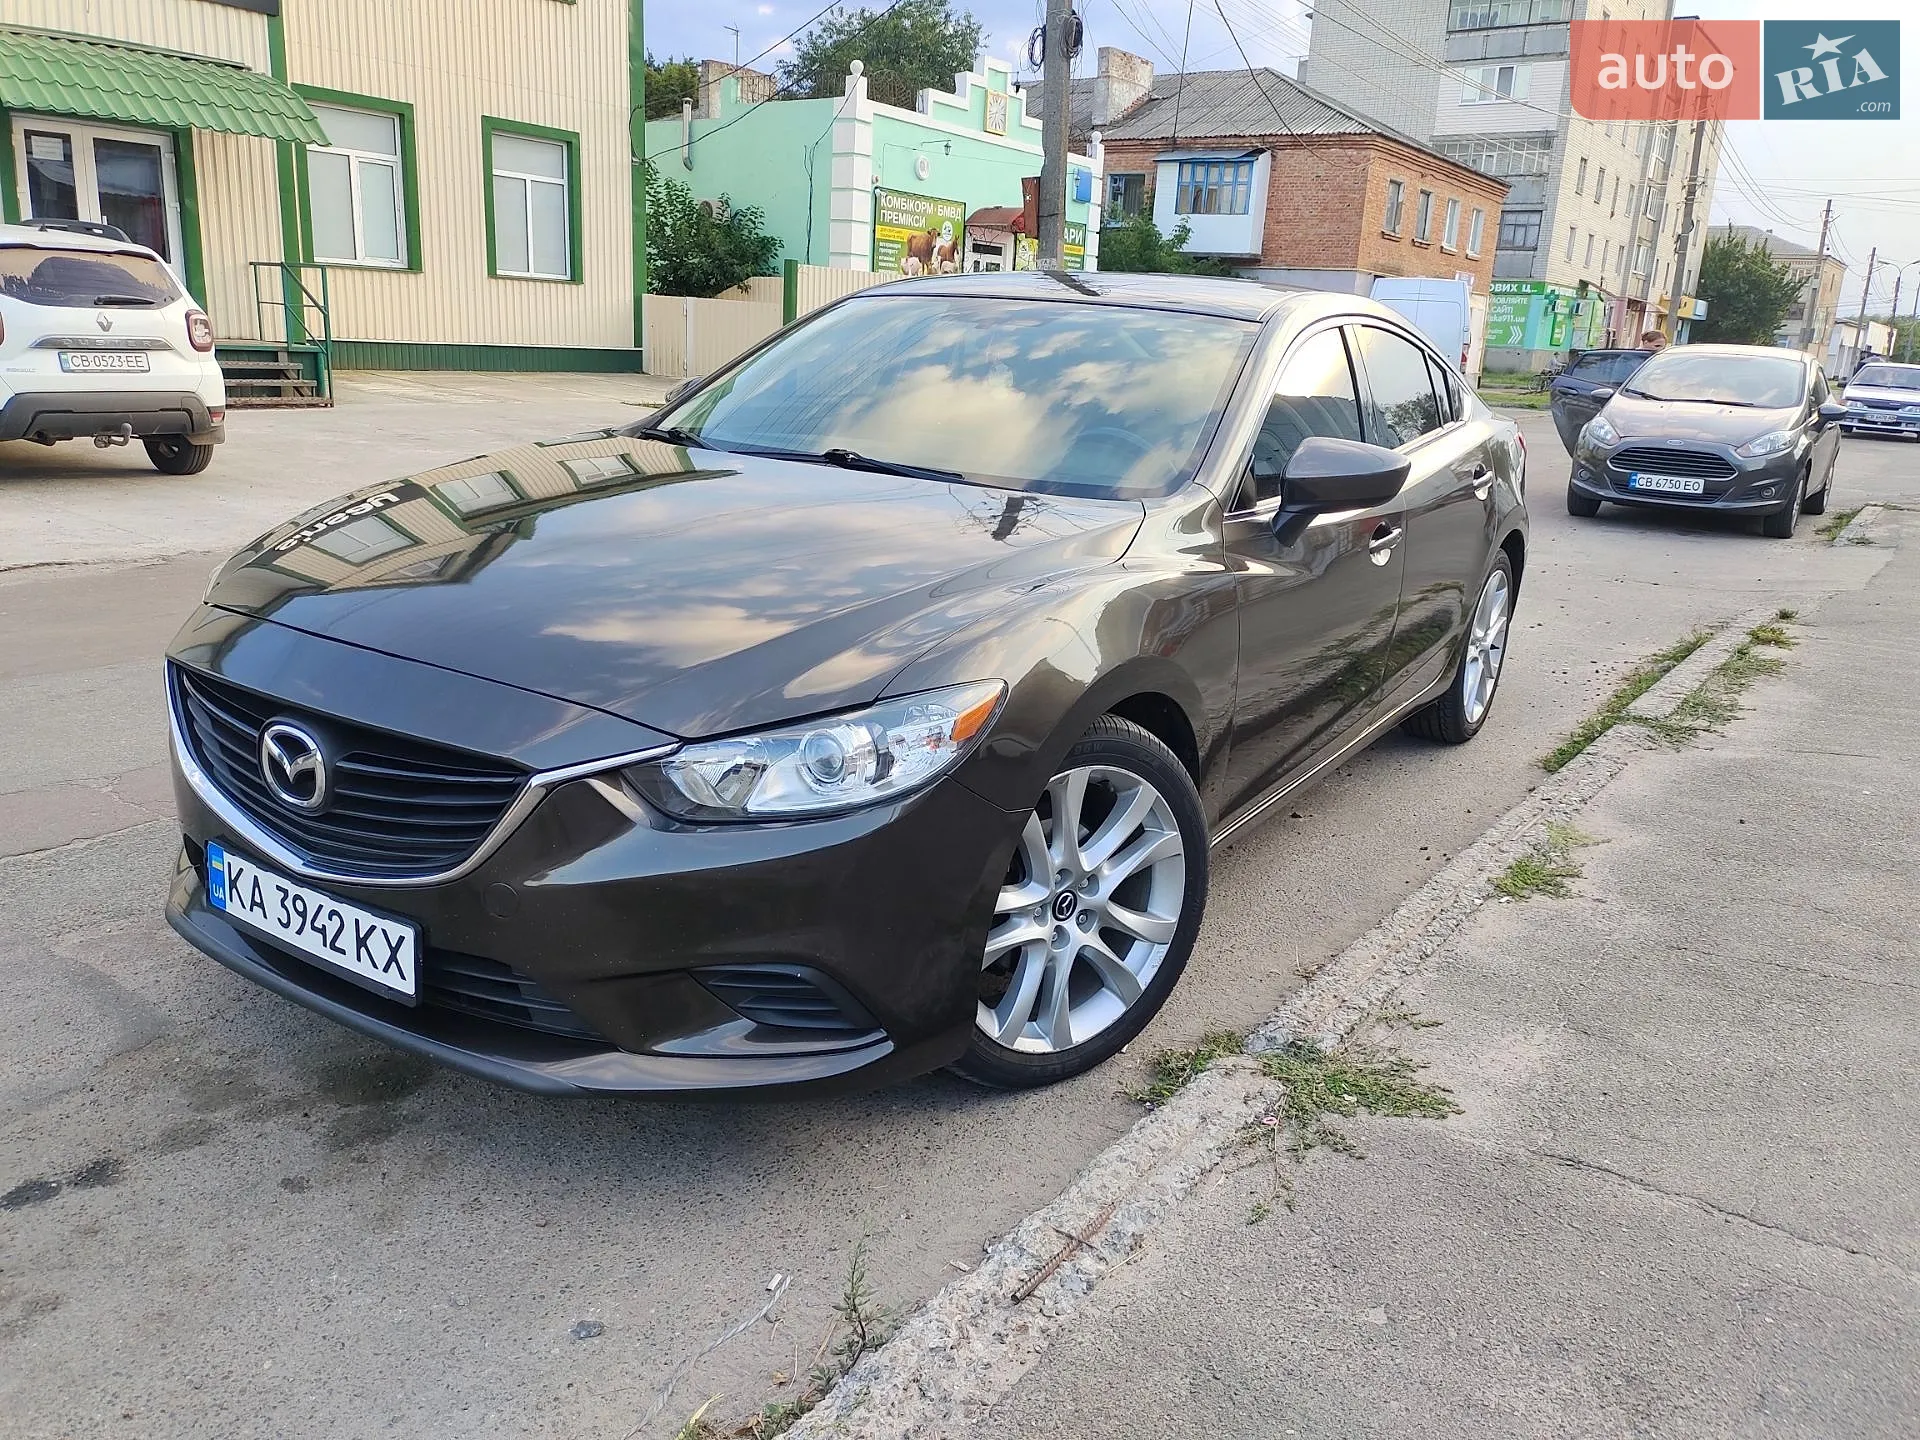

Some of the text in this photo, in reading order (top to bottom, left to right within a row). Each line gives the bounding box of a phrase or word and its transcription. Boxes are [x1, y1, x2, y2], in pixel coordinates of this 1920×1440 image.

[880, 194, 962, 222] КОМБІКОРМ БМВД
[880, 210, 926, 228] ПРЕМІКСИ
[61, 337, 153, 347] DUSTER
[1655, 478, 1681, 490] 6750
[212, 884, 226, 901] UA
[227, 861, 408, 982] KA 3942 KX
